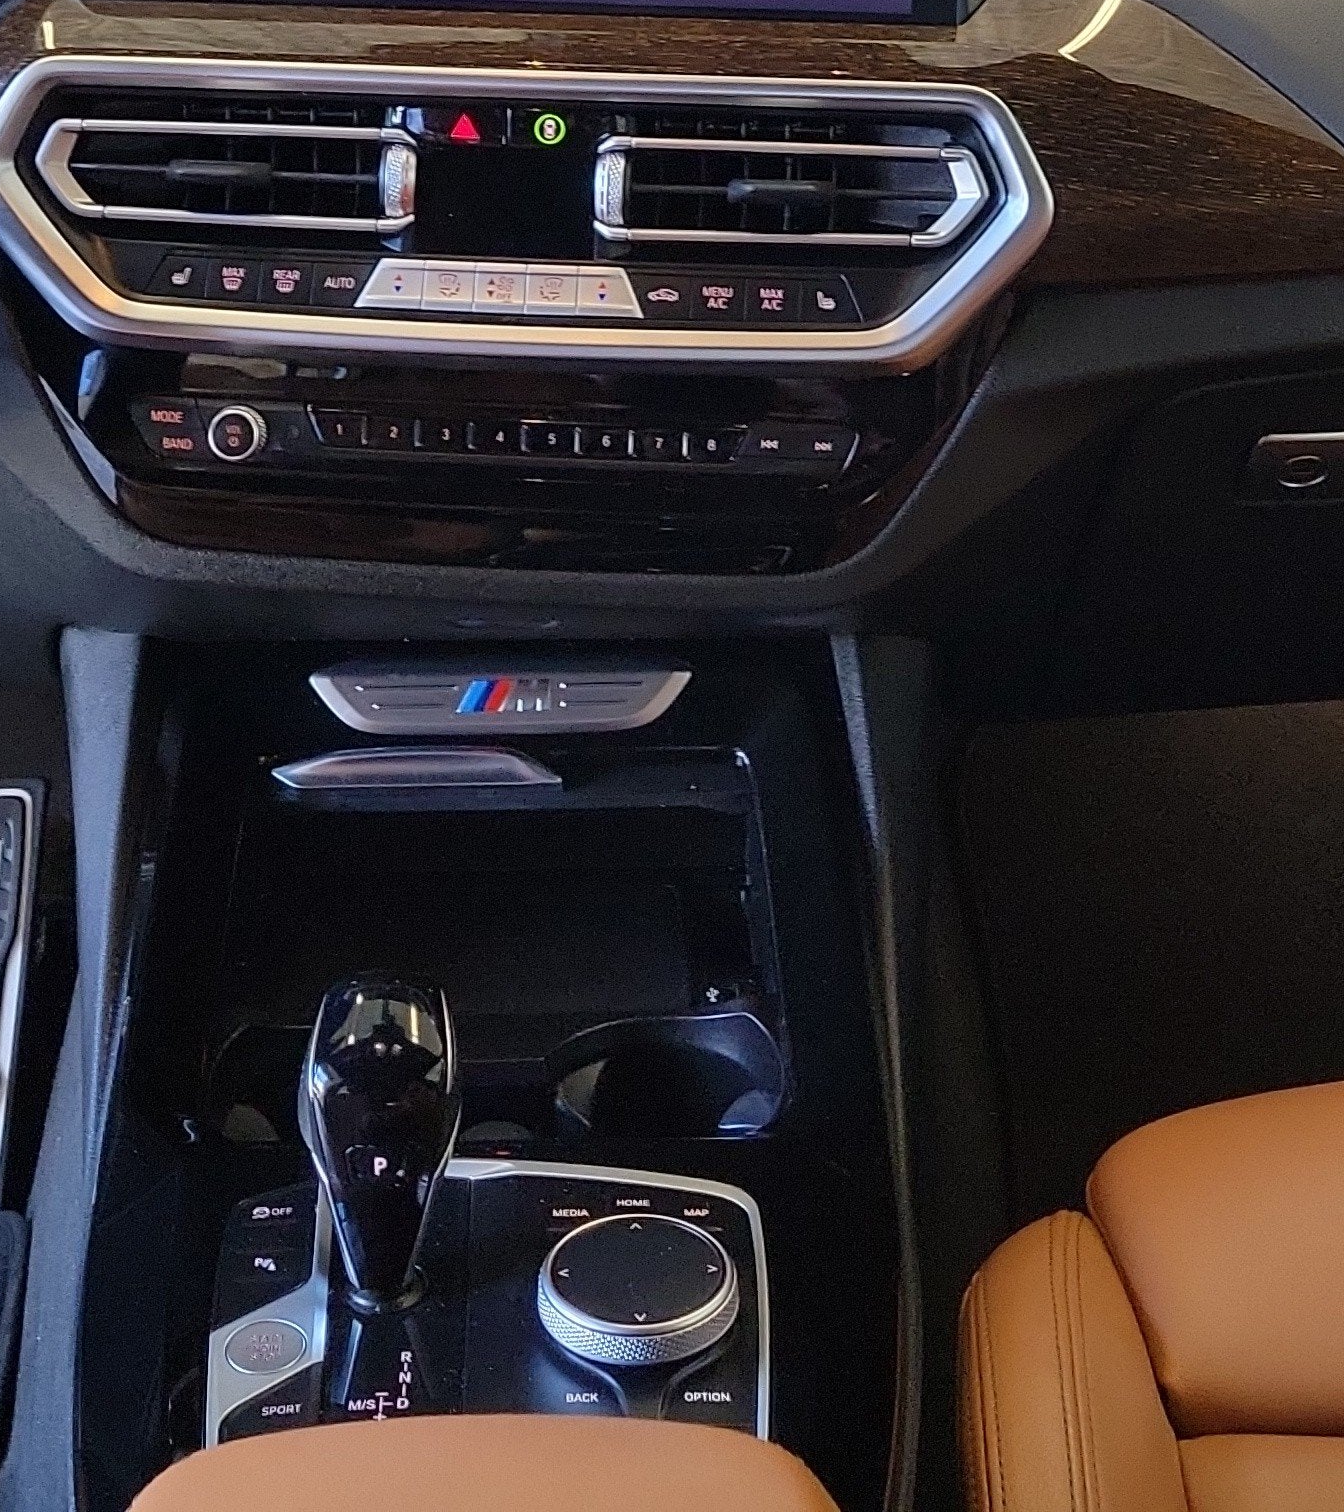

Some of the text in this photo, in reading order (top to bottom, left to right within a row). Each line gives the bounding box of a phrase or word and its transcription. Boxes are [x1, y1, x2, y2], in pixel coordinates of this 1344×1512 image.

[272, 269, 301, 280] REAR
[324, 276, 355, 289] AUTO
[759, 288, 785, 299] MAX
[707, 298, 728, 309] A/C
[761, 299, 783, 310] A/C
[150, 410, 184, 423] MODE
[335, 423, 343, 435] 1
[389, 426, 399, 438] 2
[441, 428, 451, 440] 3
[495, 431, 505, 442] 4
[547, 433, 557, 445] 5
[602, 435, 612, 447] 6
[162, 437, 194, 450] BAND
[654, 437, 664, 449] 7
[706, 439, 717, 451] 8
[373, 1156, 388, 1176] P
[616, 1199, 650, 1207] HOME
[271, 1207, 293, 1216] OFF
[552, 1208, 590, 1217] MEDIA
[683, 1208, 709, 1217] MAP
[400, 1351, 412, 1363] R
[398, 1372, 411, 1384] N
[566, 1392, 599, 1403] BACK
[683, 1391, 732, 1403] OPTION
[261, 1403, 301, 1417] SPORT
[347, 1399, 377, 1411] M/S
[396, 1398, 410, 1410] D
